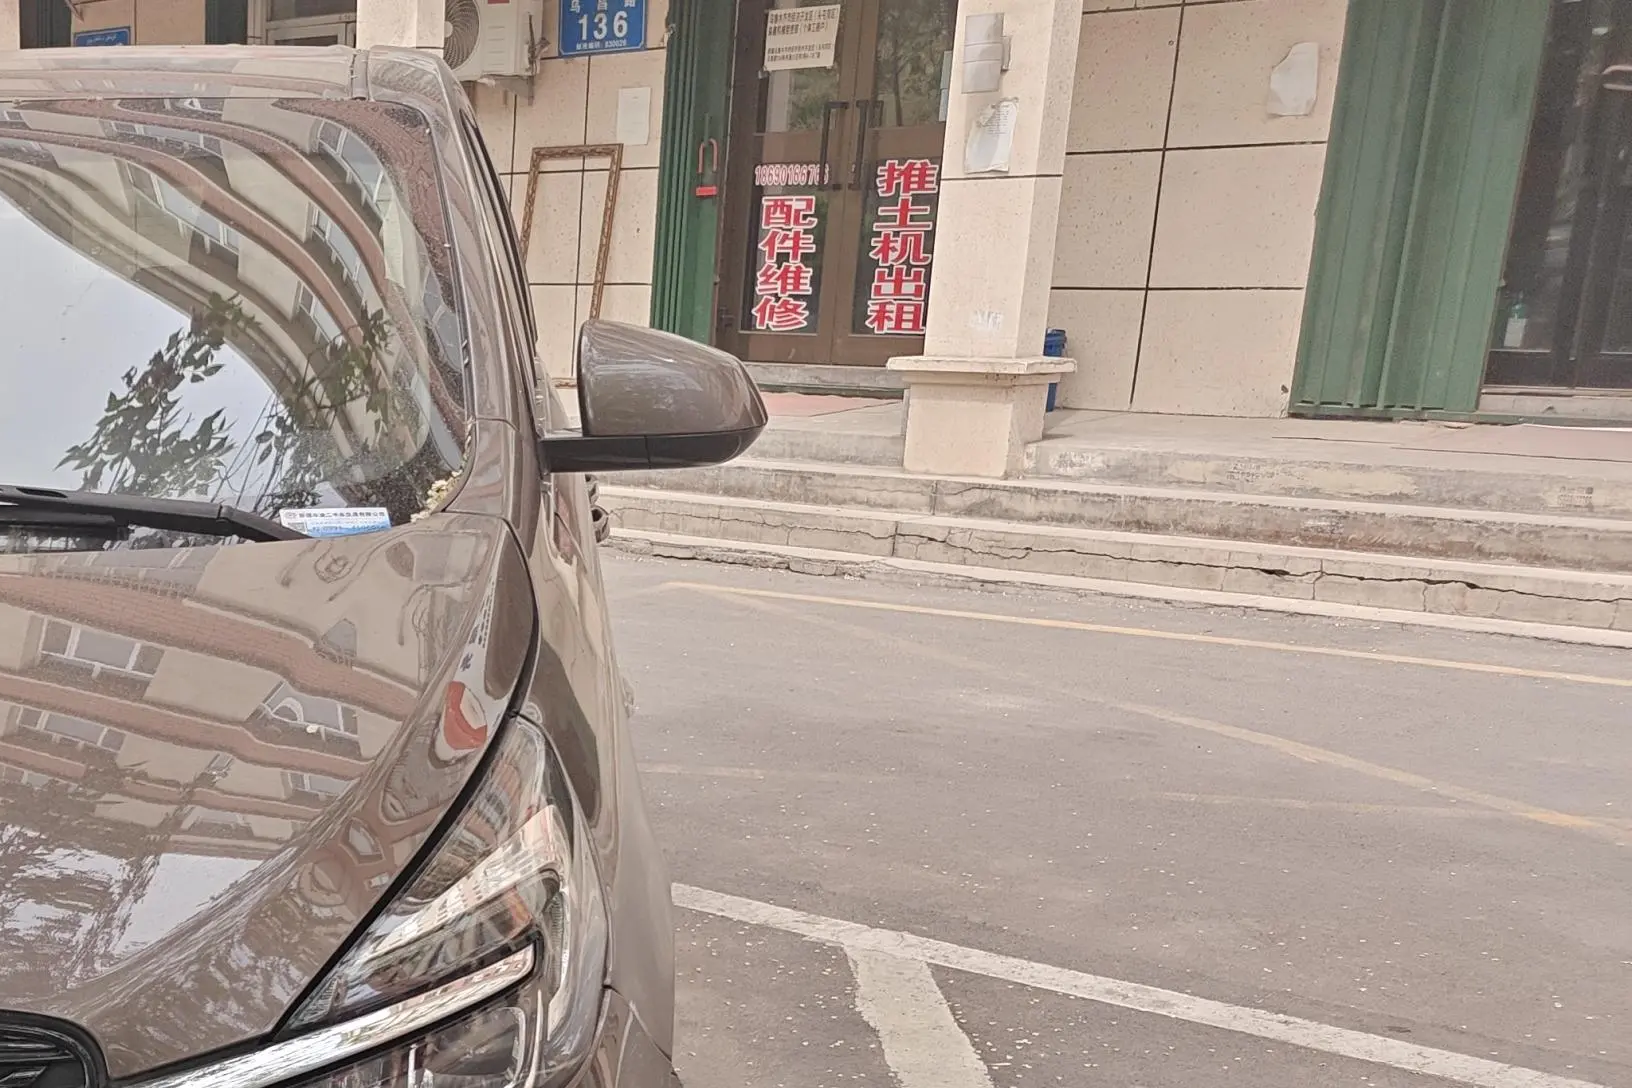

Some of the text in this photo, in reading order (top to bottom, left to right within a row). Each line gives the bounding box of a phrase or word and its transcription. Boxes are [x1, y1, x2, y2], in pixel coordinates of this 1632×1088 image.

[578, 11, 628, 40] 136
[752, 196, 817, 331] 配件维修
[865, 159, 939, 334] 推土机出租
